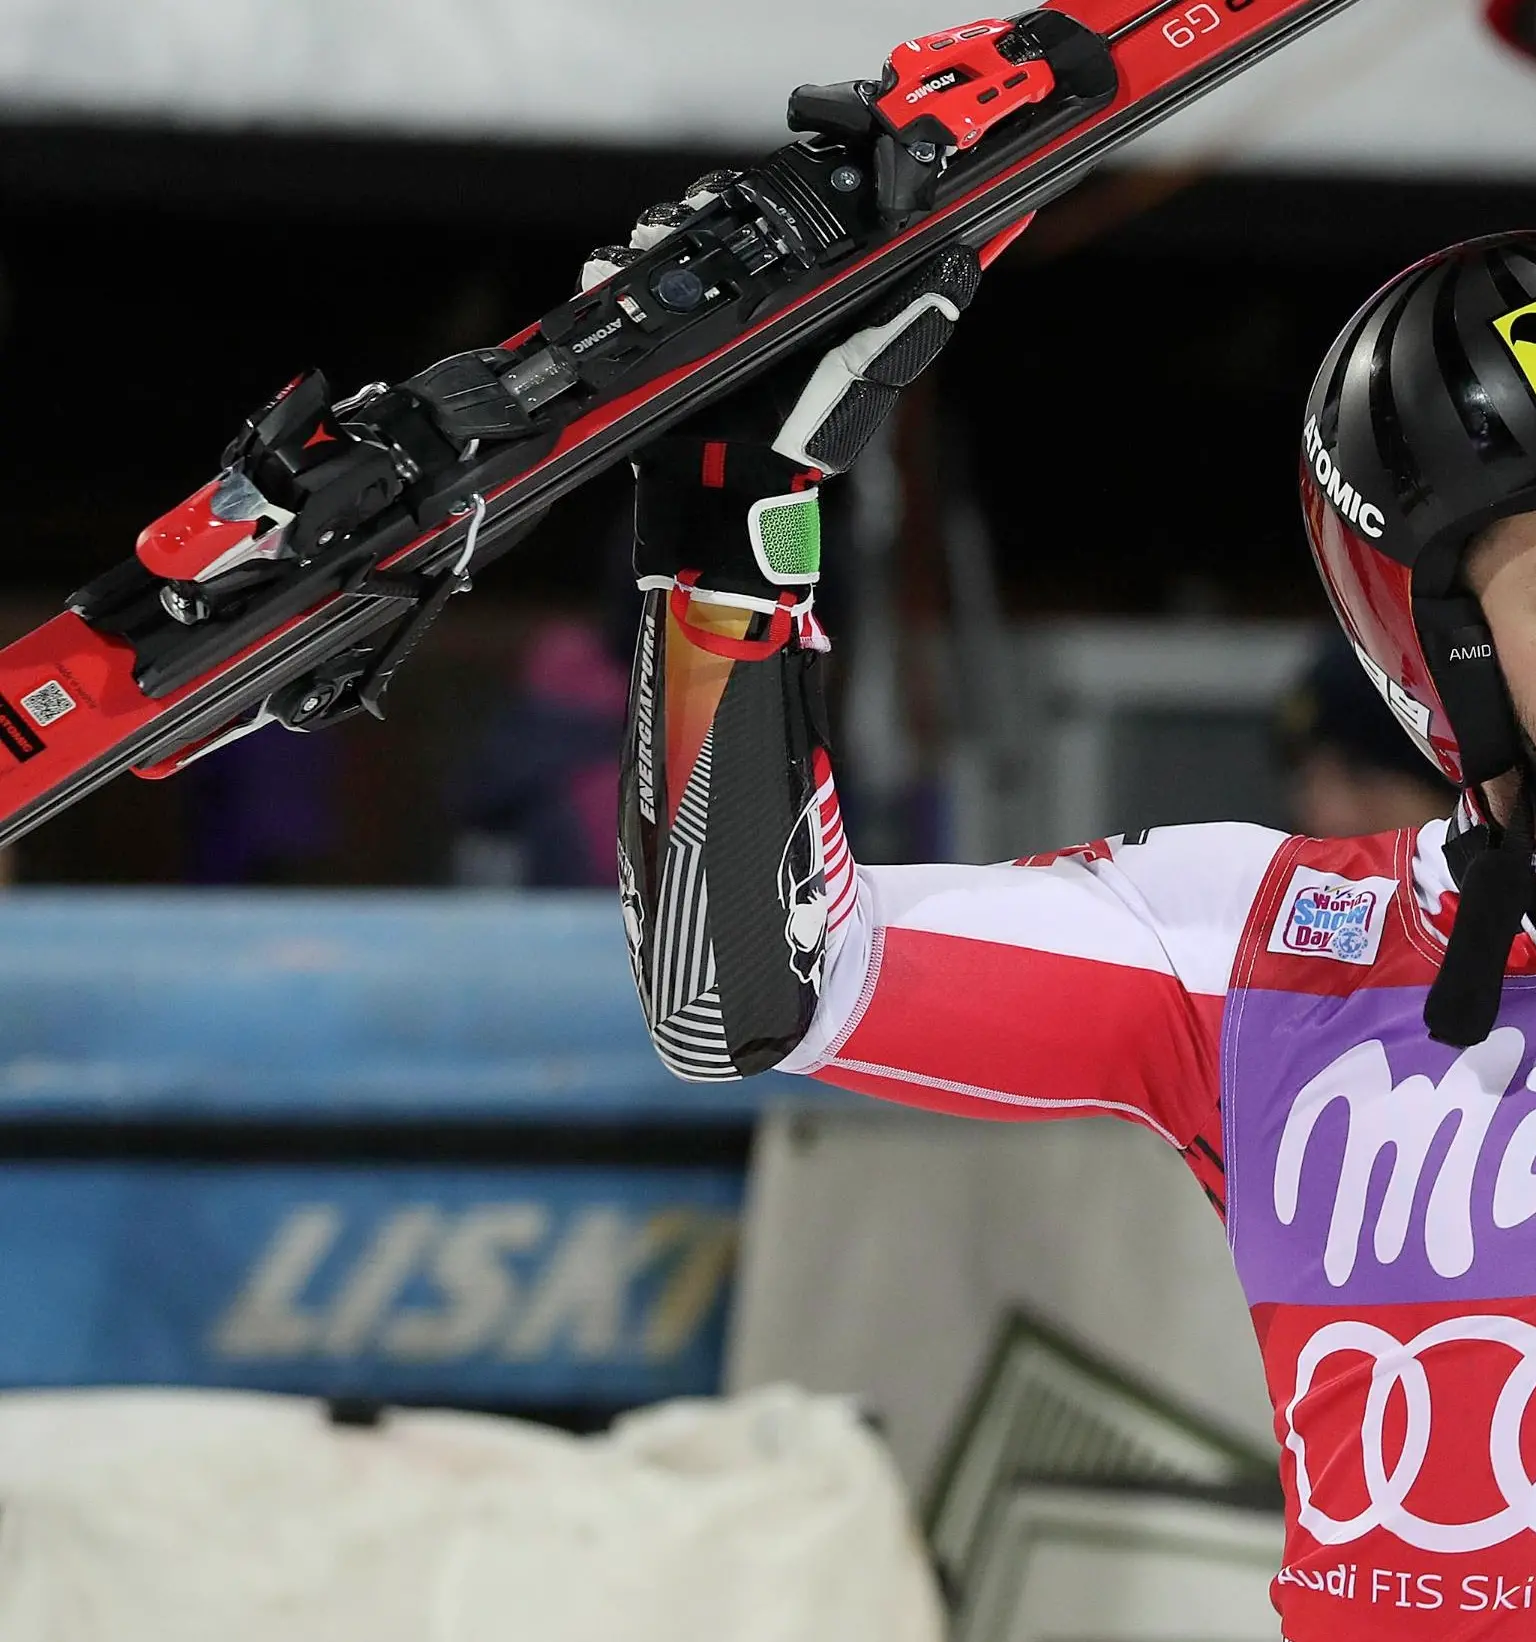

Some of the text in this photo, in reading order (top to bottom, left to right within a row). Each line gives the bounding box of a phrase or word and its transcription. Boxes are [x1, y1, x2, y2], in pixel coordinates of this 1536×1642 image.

[1161, 4, 1220, 48] G9
[905, 73, 956, 103] ATOMIC
[572, 318, 623, 353] ATOMIC
[1303, 413, 1386, 539] ATOMIC
[1449, 644, 1492, 662] AMID
[1295, 926, 1334, 948] Day
[1277, 1563, 1358, 1600] Audi
[1371, 1568, 1444, 1610] FIS
[1459, 1573, 1535, 1612] Ski
